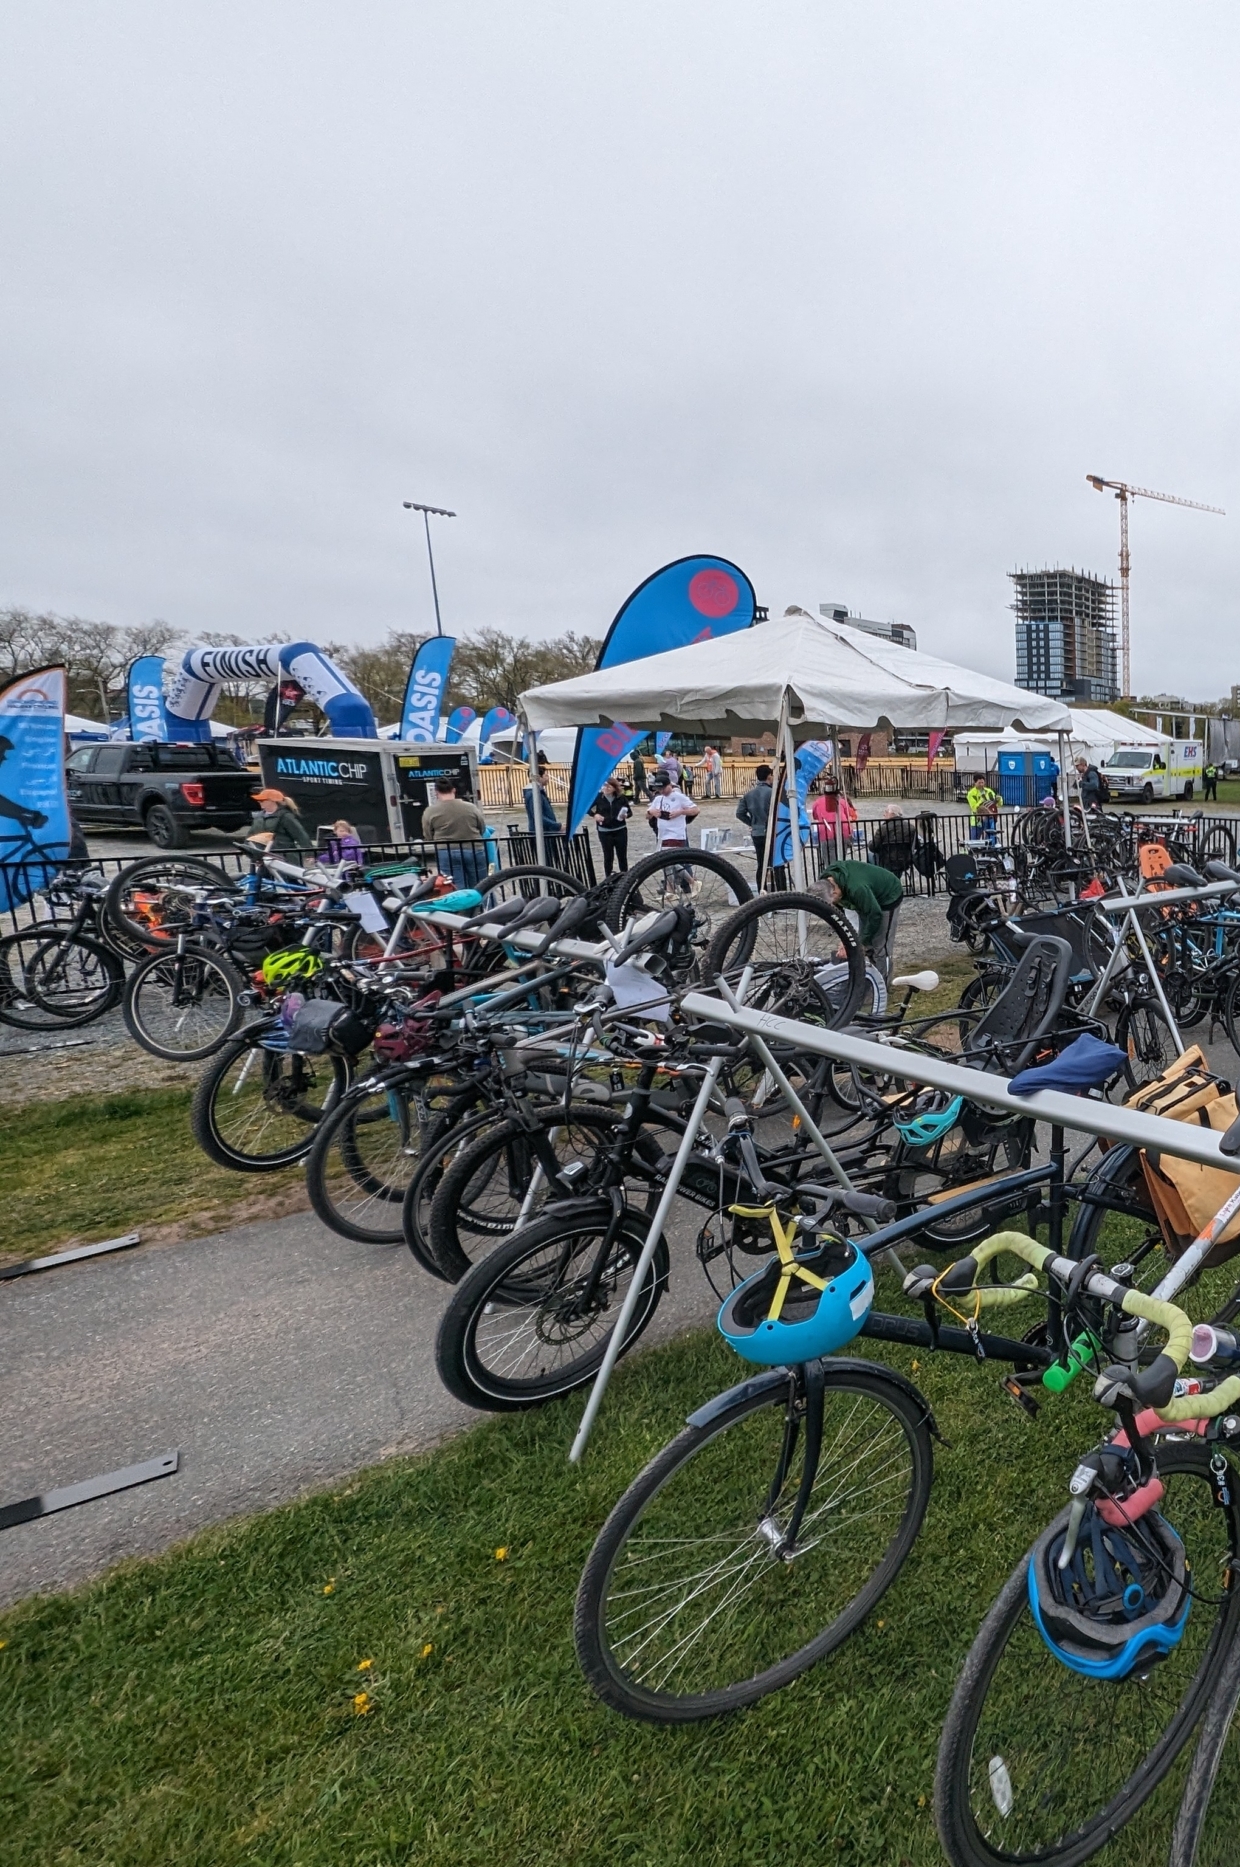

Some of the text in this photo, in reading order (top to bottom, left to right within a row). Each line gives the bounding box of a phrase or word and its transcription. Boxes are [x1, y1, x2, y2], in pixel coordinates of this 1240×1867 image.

[200, 648, 278, 679] FINISH
[1184, 746, 1197, 758] EHS
[322, 777, 343, 785] TIMING
[830, 914, 857, 947] MAXXIS
[695, 1194, 716, 1207] BIKES
